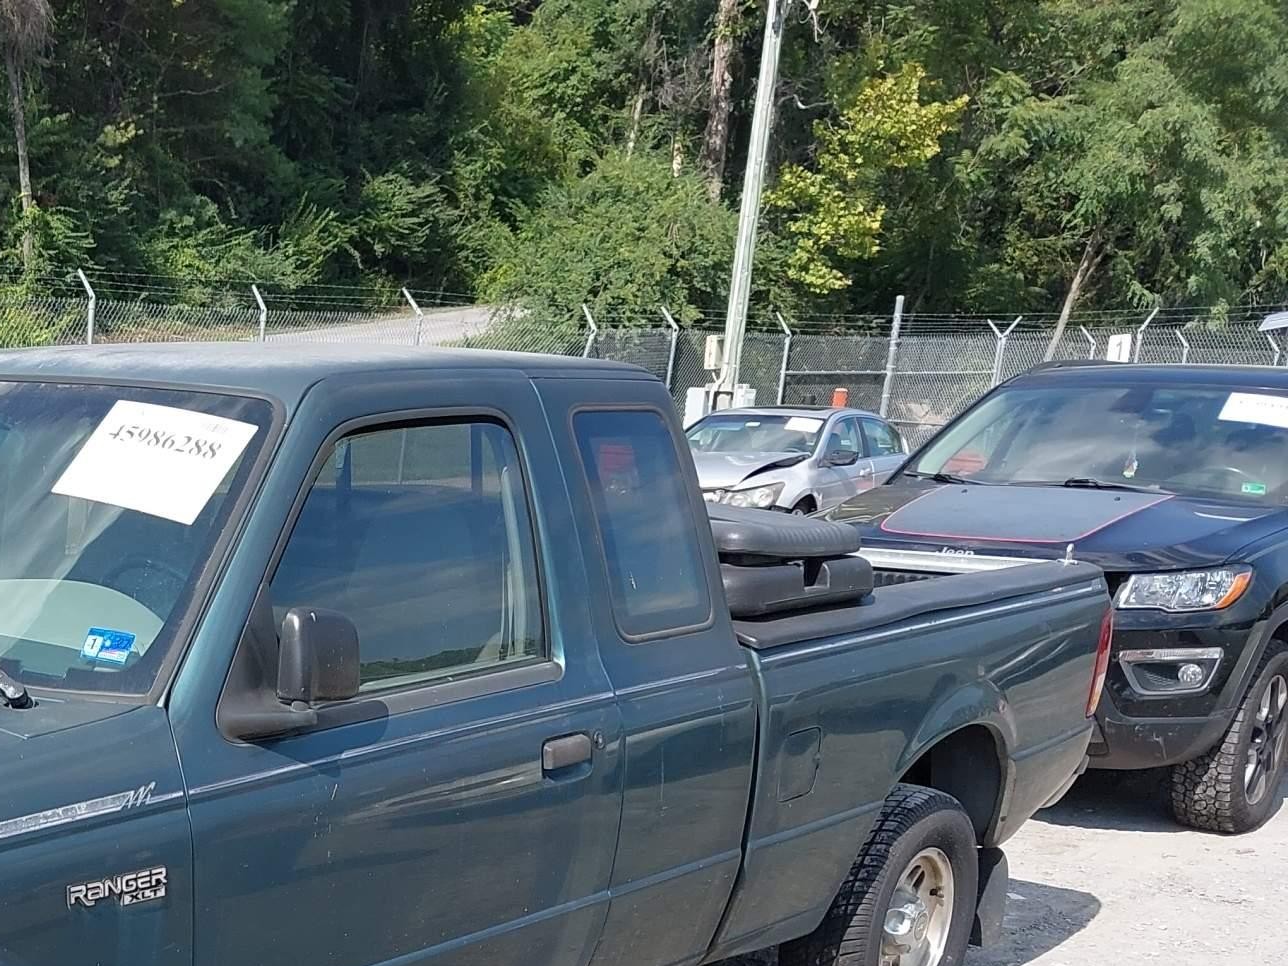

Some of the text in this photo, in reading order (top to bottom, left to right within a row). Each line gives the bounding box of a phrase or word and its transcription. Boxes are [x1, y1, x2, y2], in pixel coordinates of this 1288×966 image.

[108, 423, 222, 460] 45986288
[936, 546, 976, 558] Jeep
[67, 865, 168, 909] RANGER
[128, 887, 162, 904] XLT
